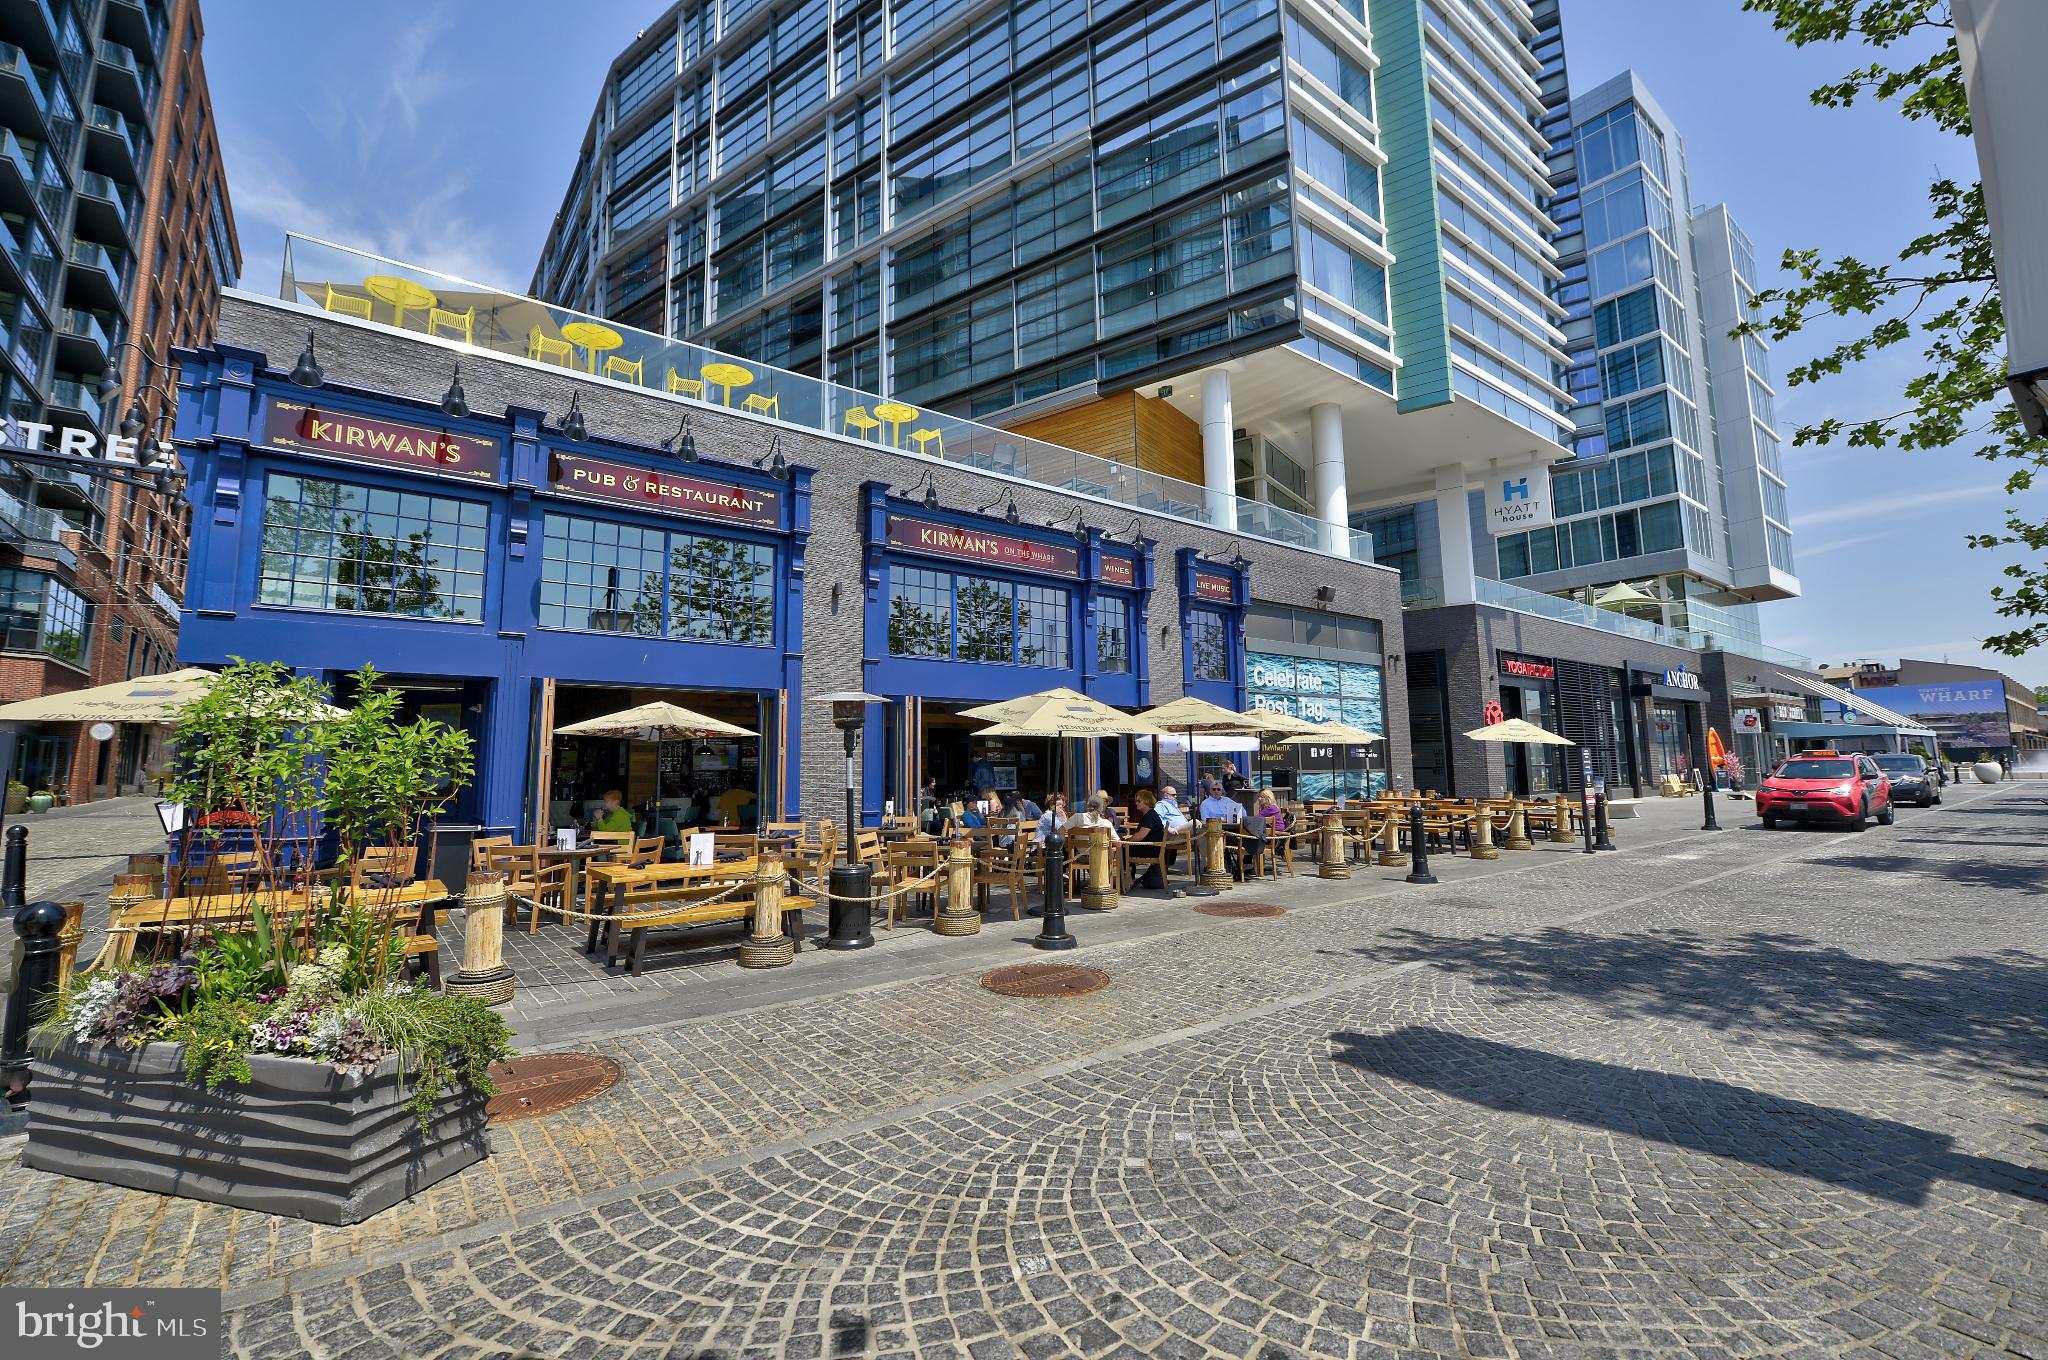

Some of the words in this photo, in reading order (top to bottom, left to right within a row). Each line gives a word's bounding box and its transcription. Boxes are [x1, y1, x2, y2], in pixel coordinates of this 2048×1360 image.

[311, 419, 461, 463] KIRWAN'S
[573, 468, 616, 486] PUB
[623, 475, 640, 492] &
[645, 481, 764, 512] RESTAURANT
[1494, 501, 1540, 517] HYATT
[1502, 512, 1534, 523] house
[921, 528, 999, 555] KIRWAN'S
[1004, 546, 1015, 555] ON
[1017, 548, 1030, 558] THE
[1031, 551, 1055, 562] WHARF
[1104, 564, 1130, 575] WINES
[1196, 580, 1211, 590] LIVE
[1211, 583, 1230, 593] MUSIC
[1253, 665, 1325, 691] Celebrate.
[1666, 670, 1700, 690] ANCHOR
[1919, 688, 1993, 703] WHARF
